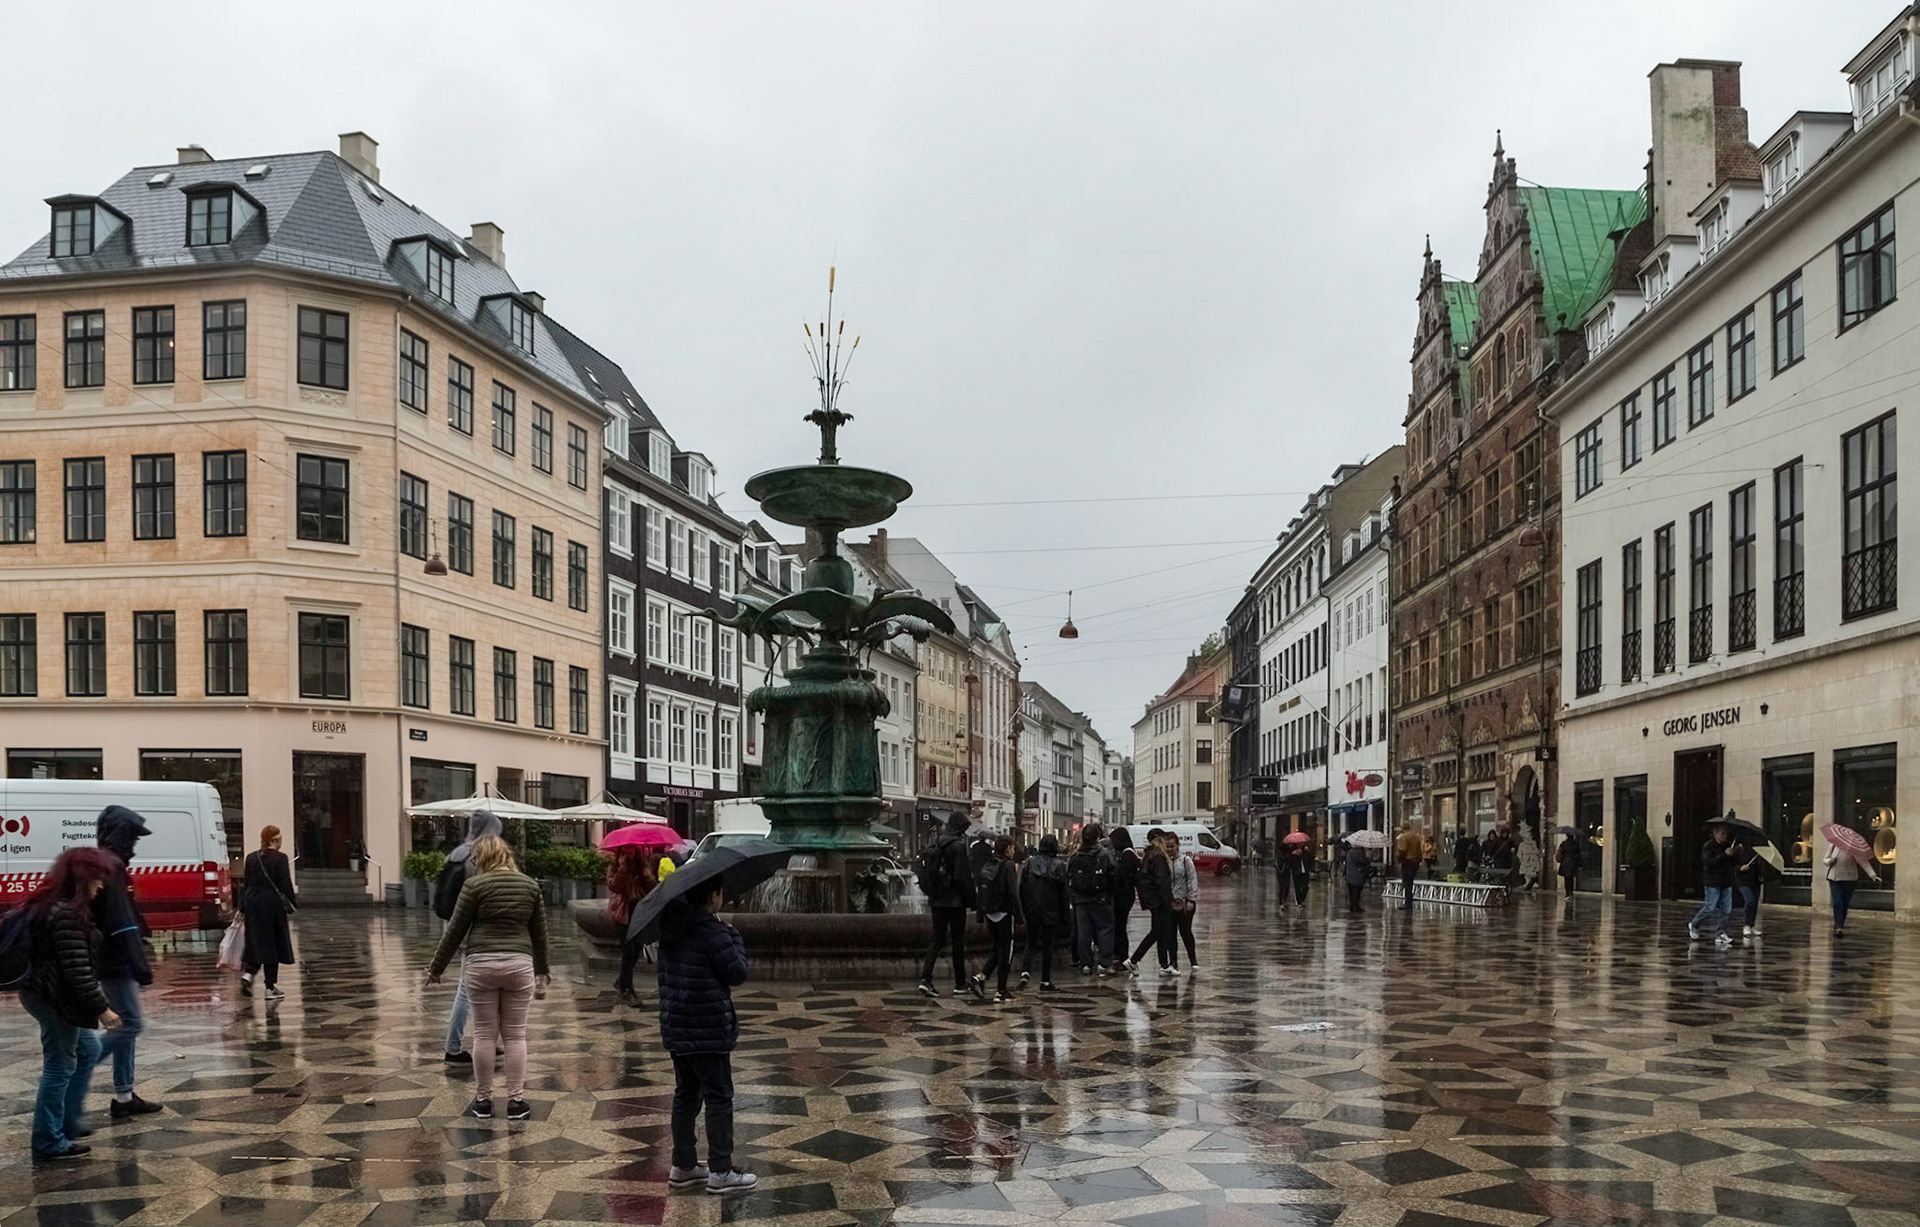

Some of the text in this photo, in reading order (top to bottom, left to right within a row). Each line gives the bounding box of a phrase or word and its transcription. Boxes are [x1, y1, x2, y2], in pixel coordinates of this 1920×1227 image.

[312, 721, 347, 732] EUROPA
[1663, 706, 1740, 736] GEORG JENSEN
[688, 788, 704, 798] SECRET
[10, 844, 31, 854] igen
[7, 881, 25, 893] 25
